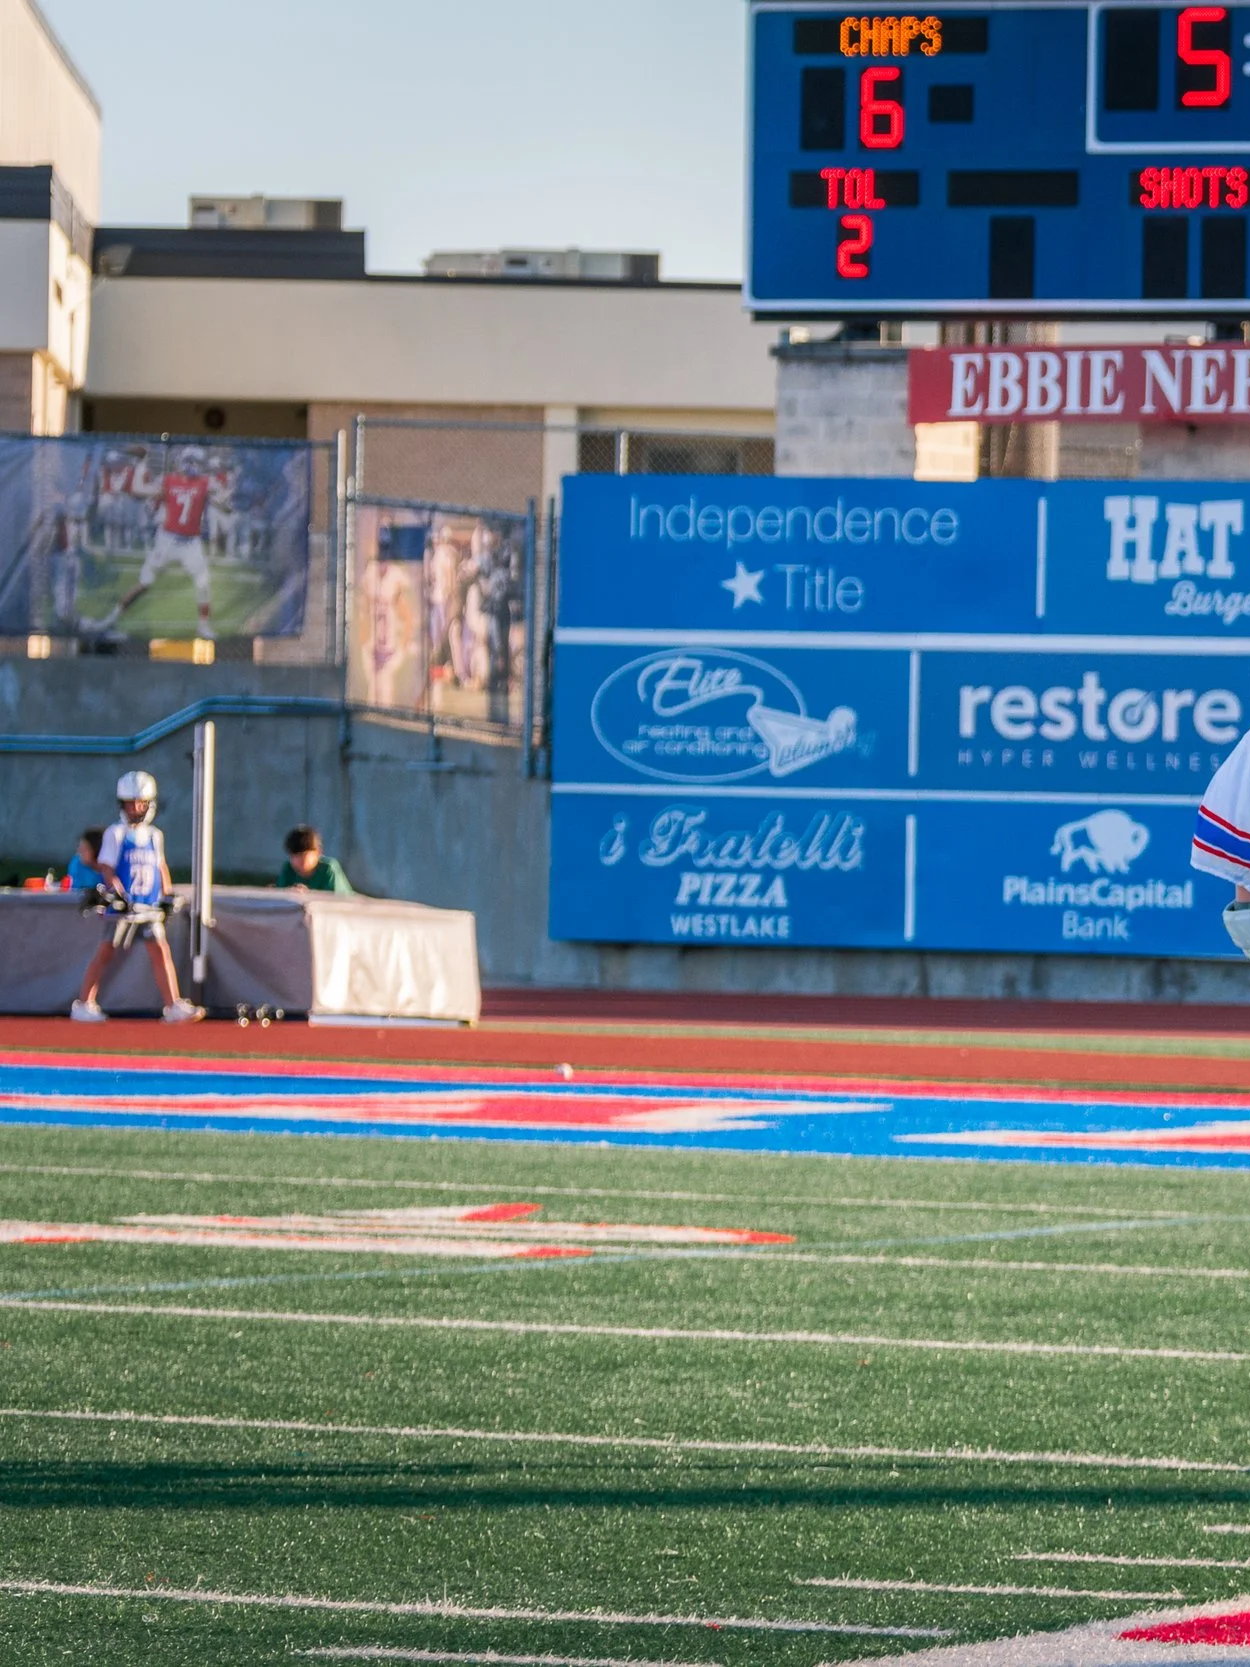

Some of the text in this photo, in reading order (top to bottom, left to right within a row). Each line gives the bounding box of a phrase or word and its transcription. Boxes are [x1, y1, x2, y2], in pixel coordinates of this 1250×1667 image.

[840, 16, 942, 56] CHAPS
[860, 67, 904, 148] 6
[821, 167, 886, 209] TOL
[1139, 166, 1249, 208] SHOTS
[837, 215, 874, 278] 2
[947, 350, 1125, 417] EBBIE
[630, 494, 959, 550] Independence
[1104, 495, 1243, 583] HAT
[774, 563, 864, 613] Title
[958, 670, 1242, 744] restore
[958, 748, 1220, 772] HYPER WELLNES
[674, 872, 788, 908] PIZZA
[1002, 876, 1194, 912] PlainsCapital
[670, 913, 791, 938] WESTLAKE
[1062, 910, 1130, 942] Bank
